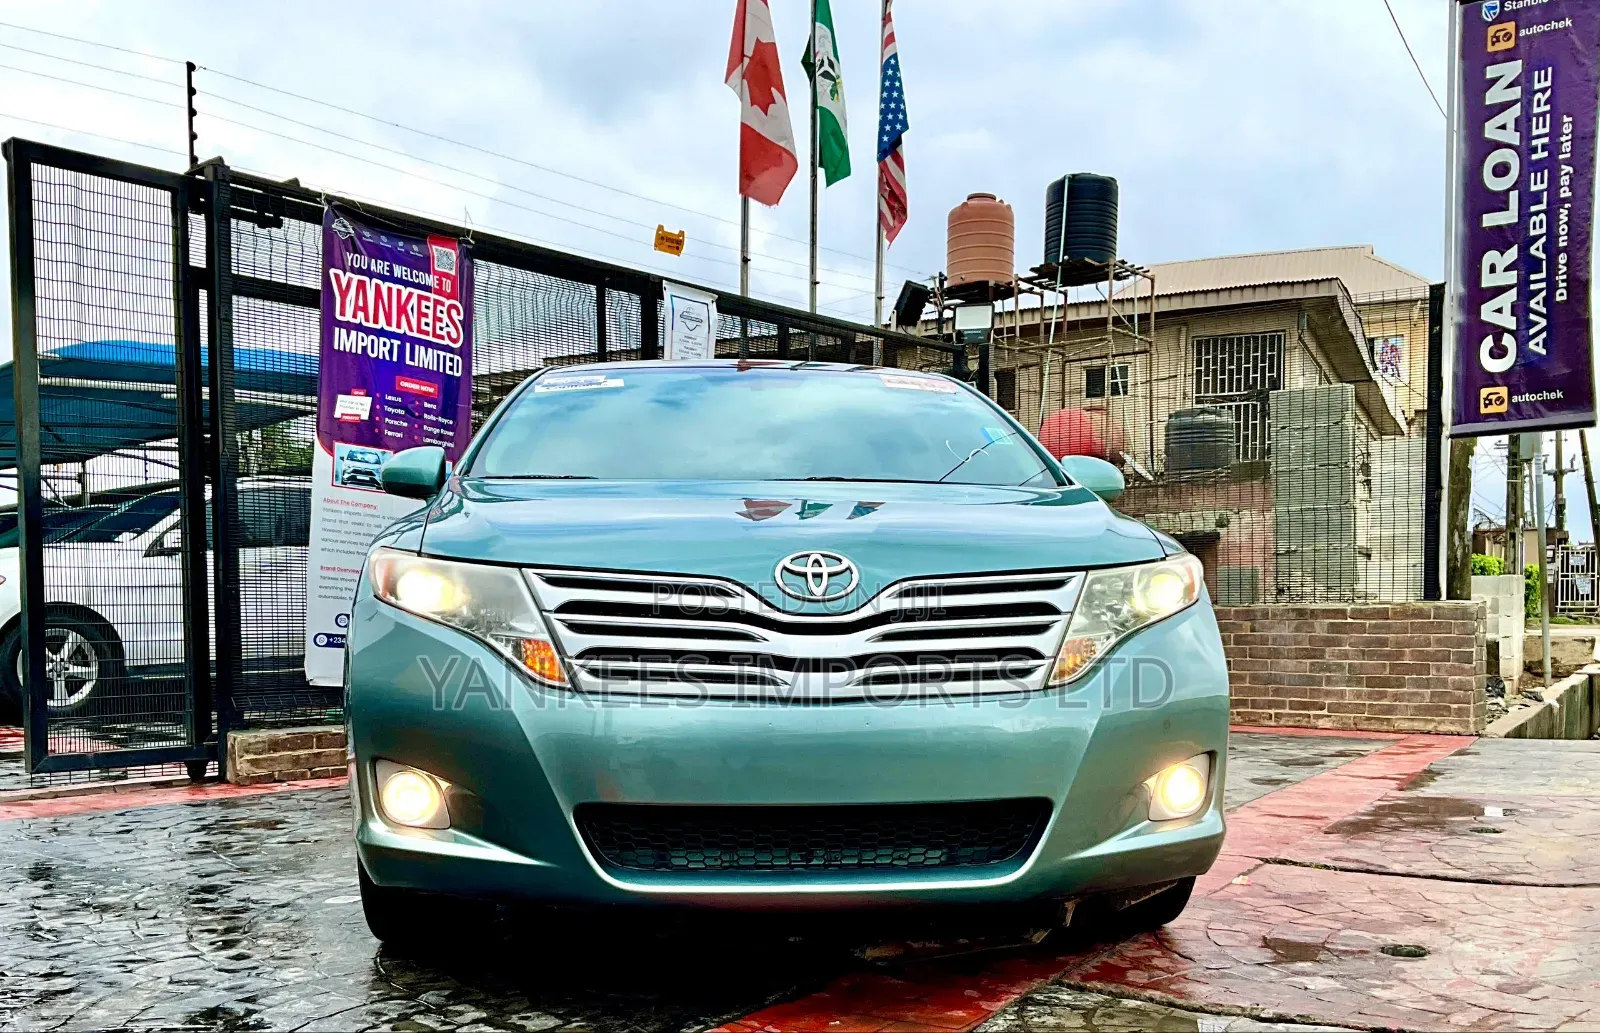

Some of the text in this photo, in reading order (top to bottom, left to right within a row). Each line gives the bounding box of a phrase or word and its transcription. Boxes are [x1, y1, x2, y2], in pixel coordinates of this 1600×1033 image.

[1503, 0, 1549, 11] Stan
[1520, 18, 1573, 37] autochek
[1528, 66, 1553, 356] AVAILABLE HERE
[1556, 114, 1574, 302] Drive now, pay later
[1479, 59, 1523, 373] CAR LOAN
[346, 252, 452, 293] YOU ARE WELCOME TO
[329, 268, 464, 348] YANKEES
[333, 327, 462, 377] IMPORT LIMITED
[400, 381, 435, 393] ORDER NOW
[385, 394, 402, 402] Lexus
[1512, 389, 1564, 403] autochek
[384, 405, 405, 415] Toyota
[423, 401, 437, 410] Benz
[384, 417, 408, 427] Porsche
[423, 413, 454, 425] Rolls-Royce
[384, 429, 404, 438] Ferrari
[423, 425, 455, 437] Range Rover
[422, 437, 455, 448] Lamborghini
